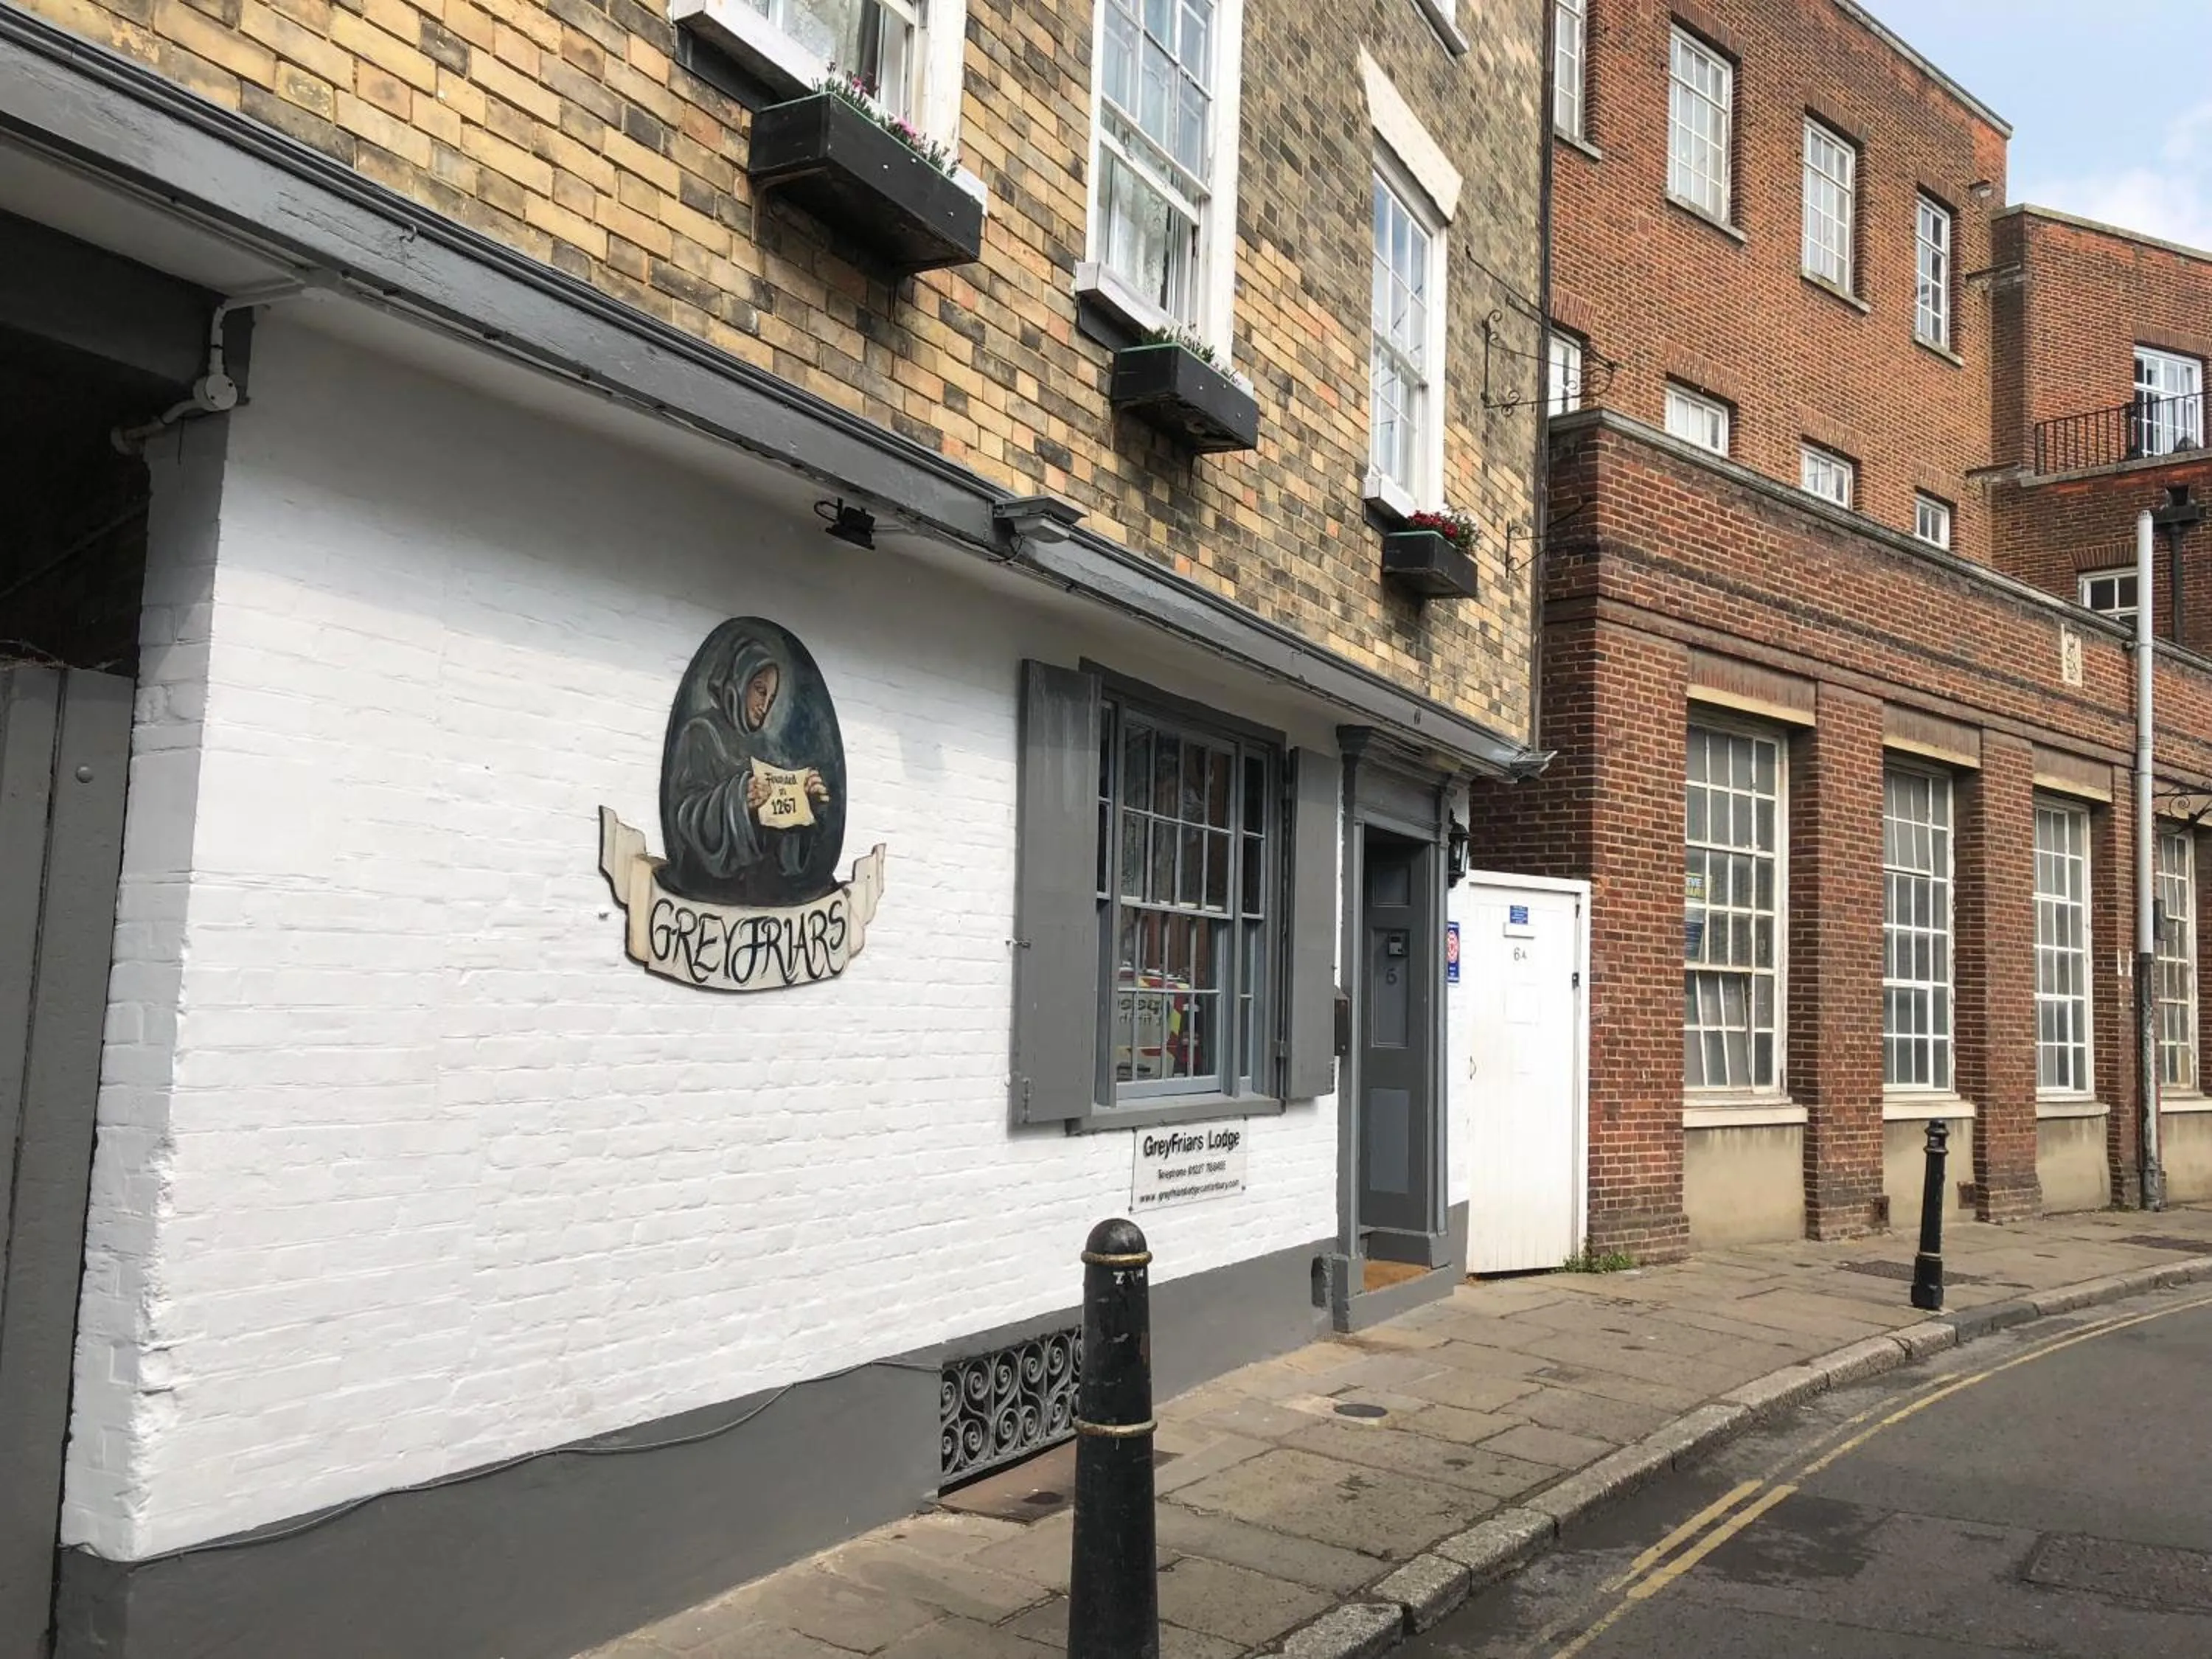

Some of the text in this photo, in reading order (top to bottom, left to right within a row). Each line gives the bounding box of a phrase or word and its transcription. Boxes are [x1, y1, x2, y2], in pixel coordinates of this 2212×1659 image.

[771, 797, 796, 815] 1267
[649, 897, 846, 984] GREYFRIARS
[1144, 1127, 1240, 1160] GreyFriars Lodge
